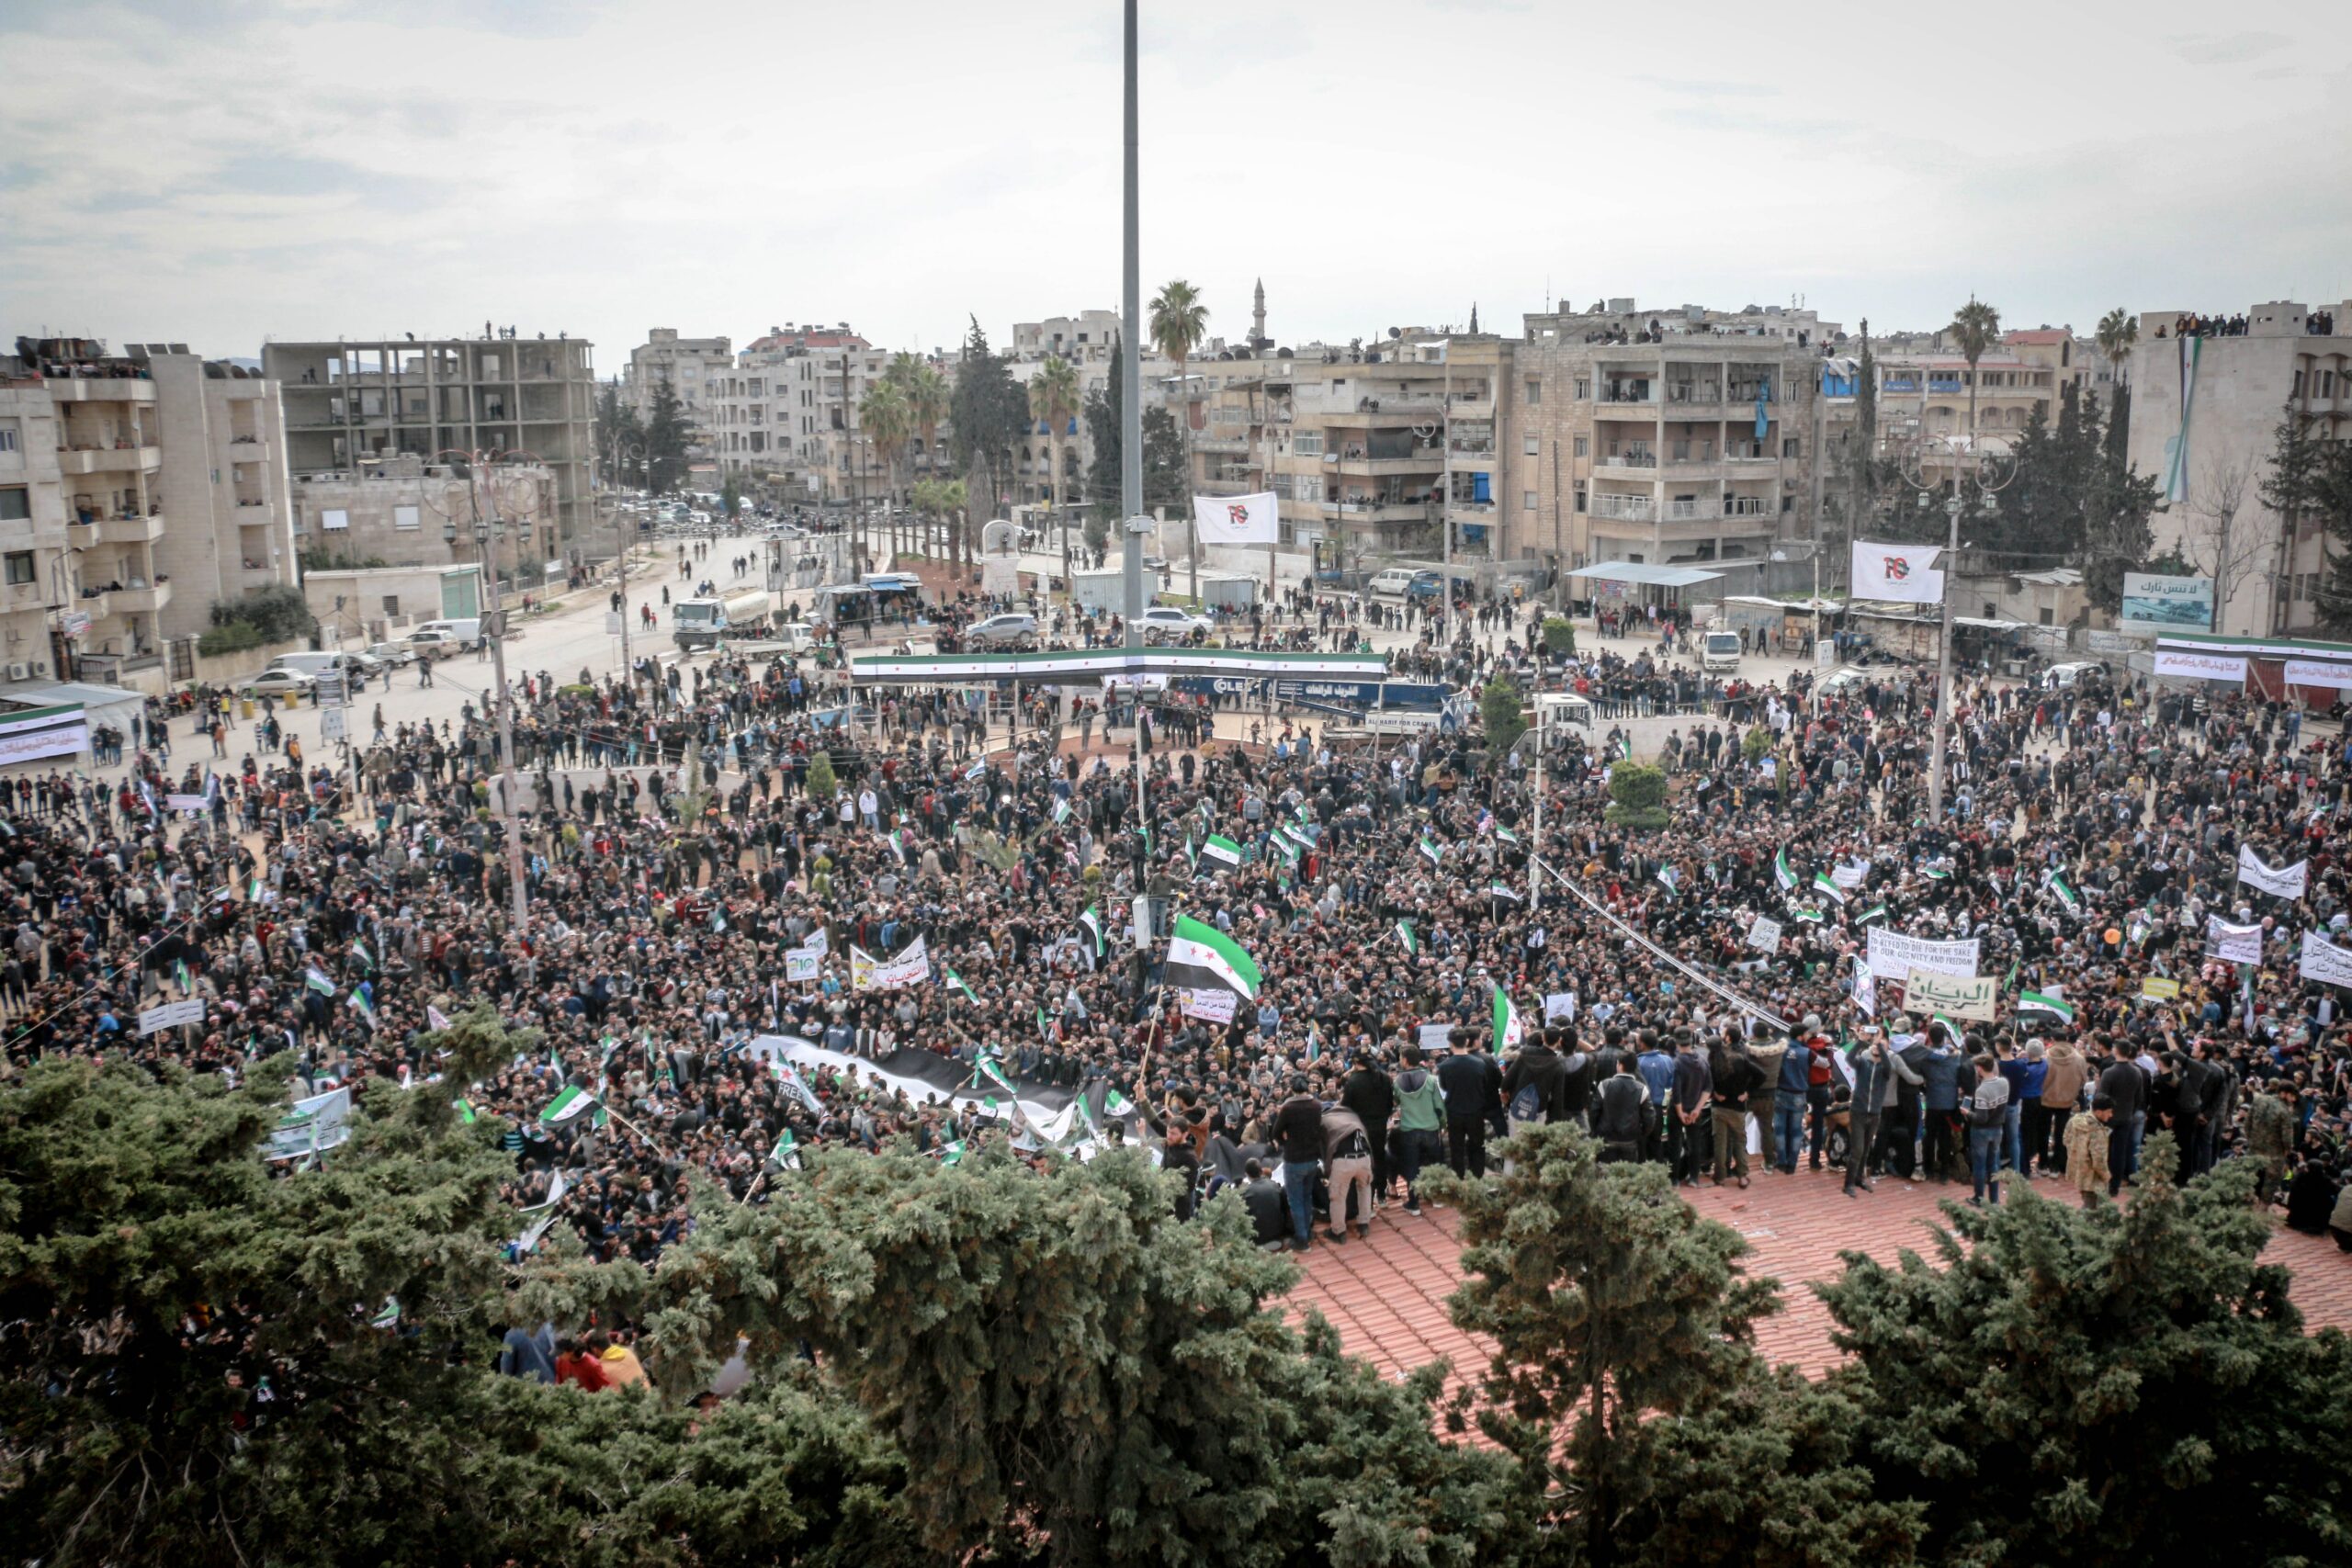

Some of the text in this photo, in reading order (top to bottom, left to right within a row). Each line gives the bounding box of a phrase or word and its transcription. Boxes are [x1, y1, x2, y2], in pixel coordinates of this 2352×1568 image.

[1871, 946, 1973, 965] OF OUR DIGNITY AND FREEDOM
[1911, 944, 1922, 953] DIE
[1925, 946, 1937, 954] FOR
[1939, 947, 1952, 955] THE
[1954, 948, 1971, 957] SAKE
[778, 1082, 802, 1101] FREE
